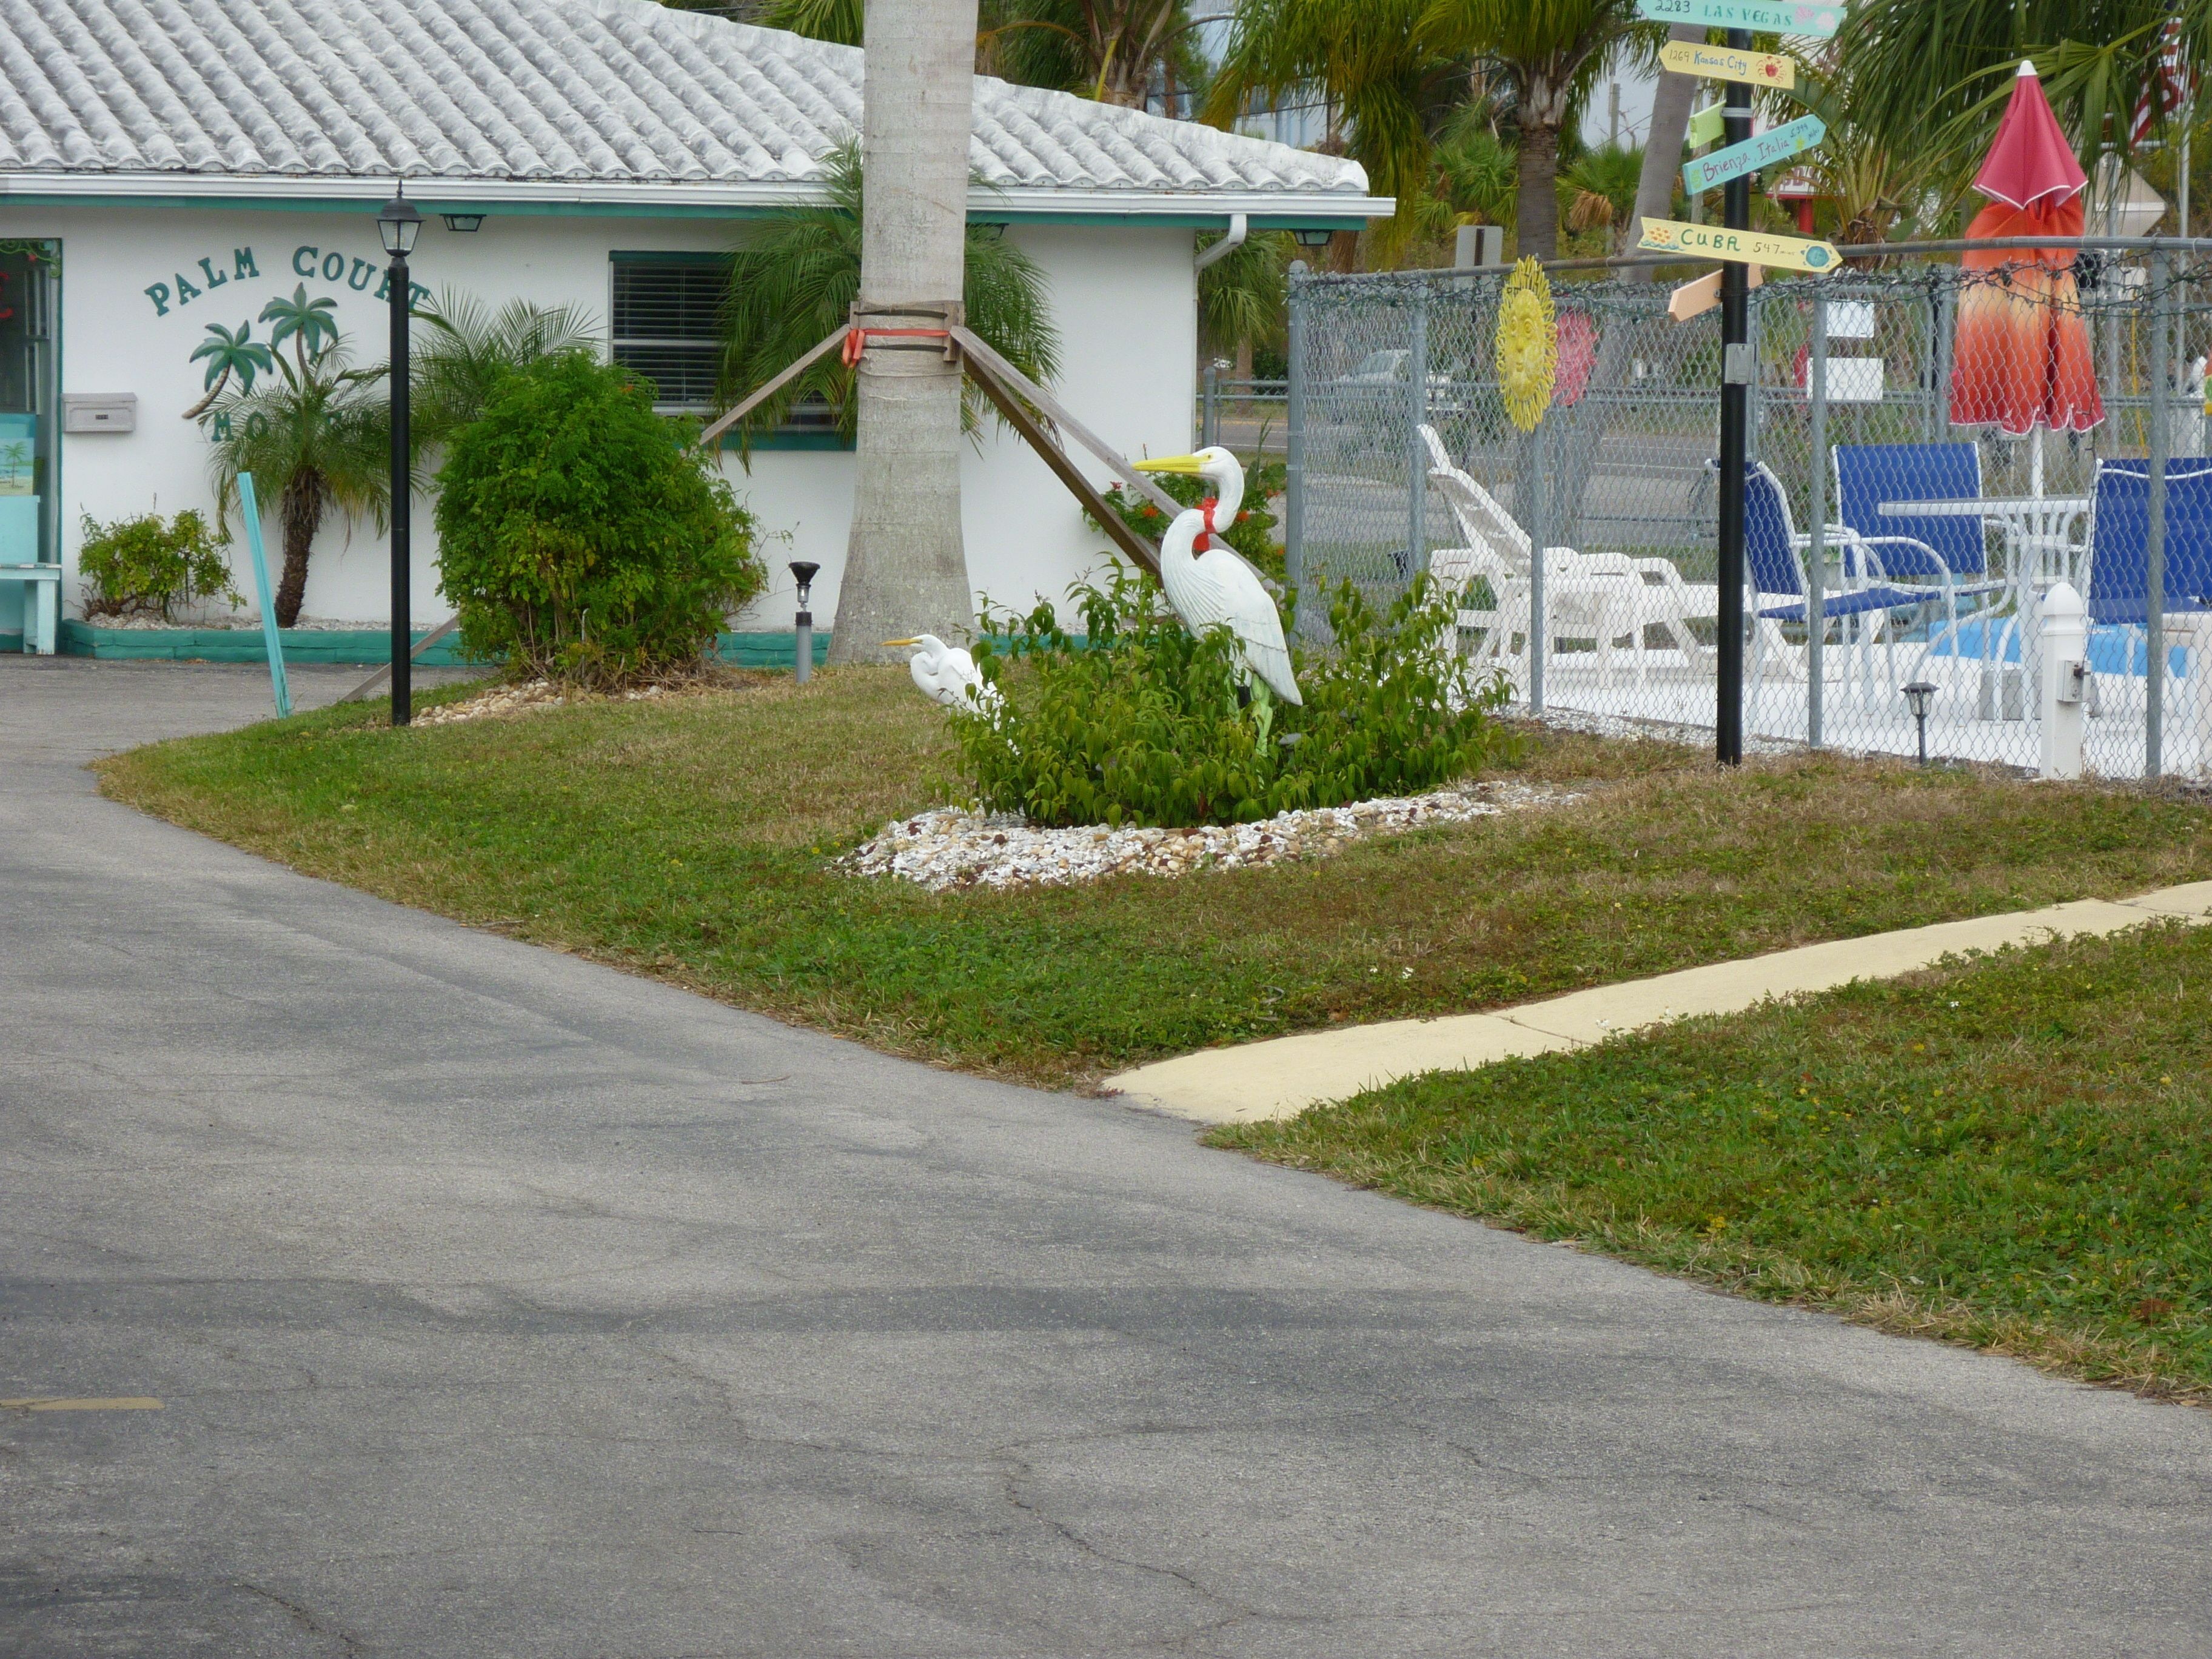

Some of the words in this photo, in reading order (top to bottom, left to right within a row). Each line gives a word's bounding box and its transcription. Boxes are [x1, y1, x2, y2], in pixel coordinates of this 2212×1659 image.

[1655, 0, 1691, 13] 2283
[1704, 4, 1734, 19] LAS
[1742, 8, 1792, 26] VEGAS
[1669, 49, 1690, 63] 1269
[1694, 50, 1725, 67] Kansas
[1727, 55, 1747, 76] City
[1757, 137, 1790, 161] Italia
[1681, 228, 1741, 252] CUBA
[1752, 241, 1780, 255] 547
[143, 246, 260, 317] PALM
